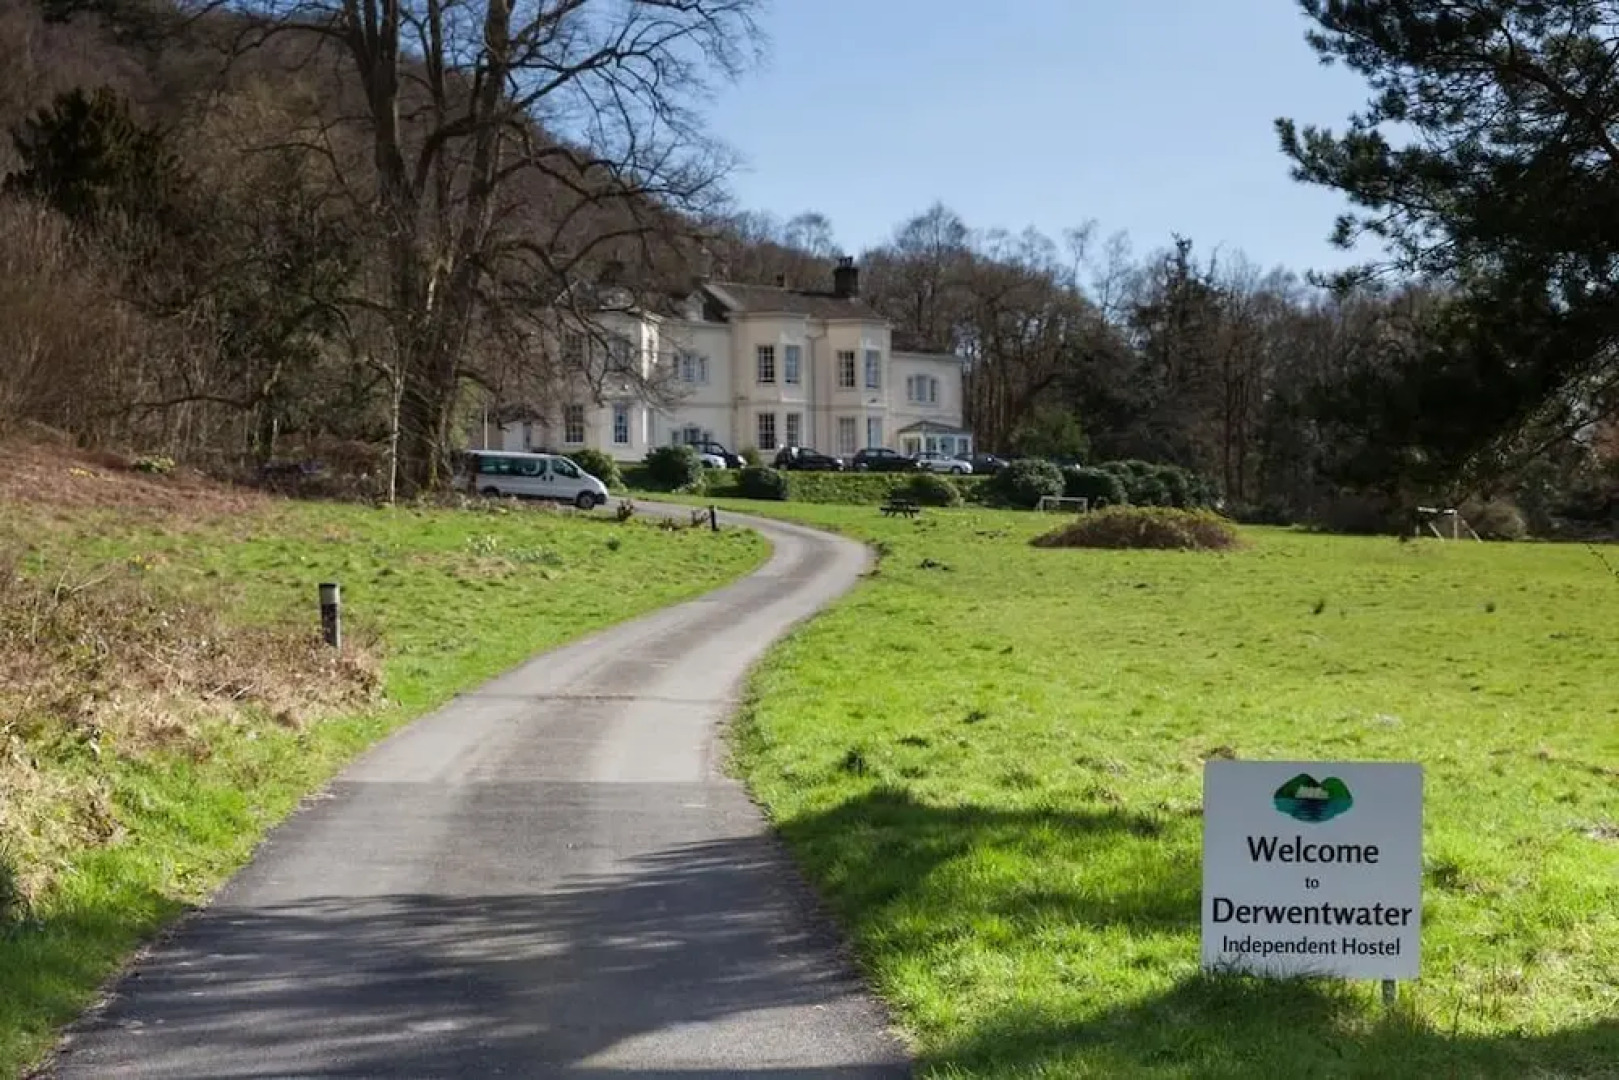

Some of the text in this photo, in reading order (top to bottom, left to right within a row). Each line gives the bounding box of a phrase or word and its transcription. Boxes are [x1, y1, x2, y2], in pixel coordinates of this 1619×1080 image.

[1247, 835, 1380, 864] Welcome
[1304, 876, 1320, 890] to
[1212, 896, 1413, 927] Derwentwater
[1222, 935, 1401, 957] Independent Hostel
